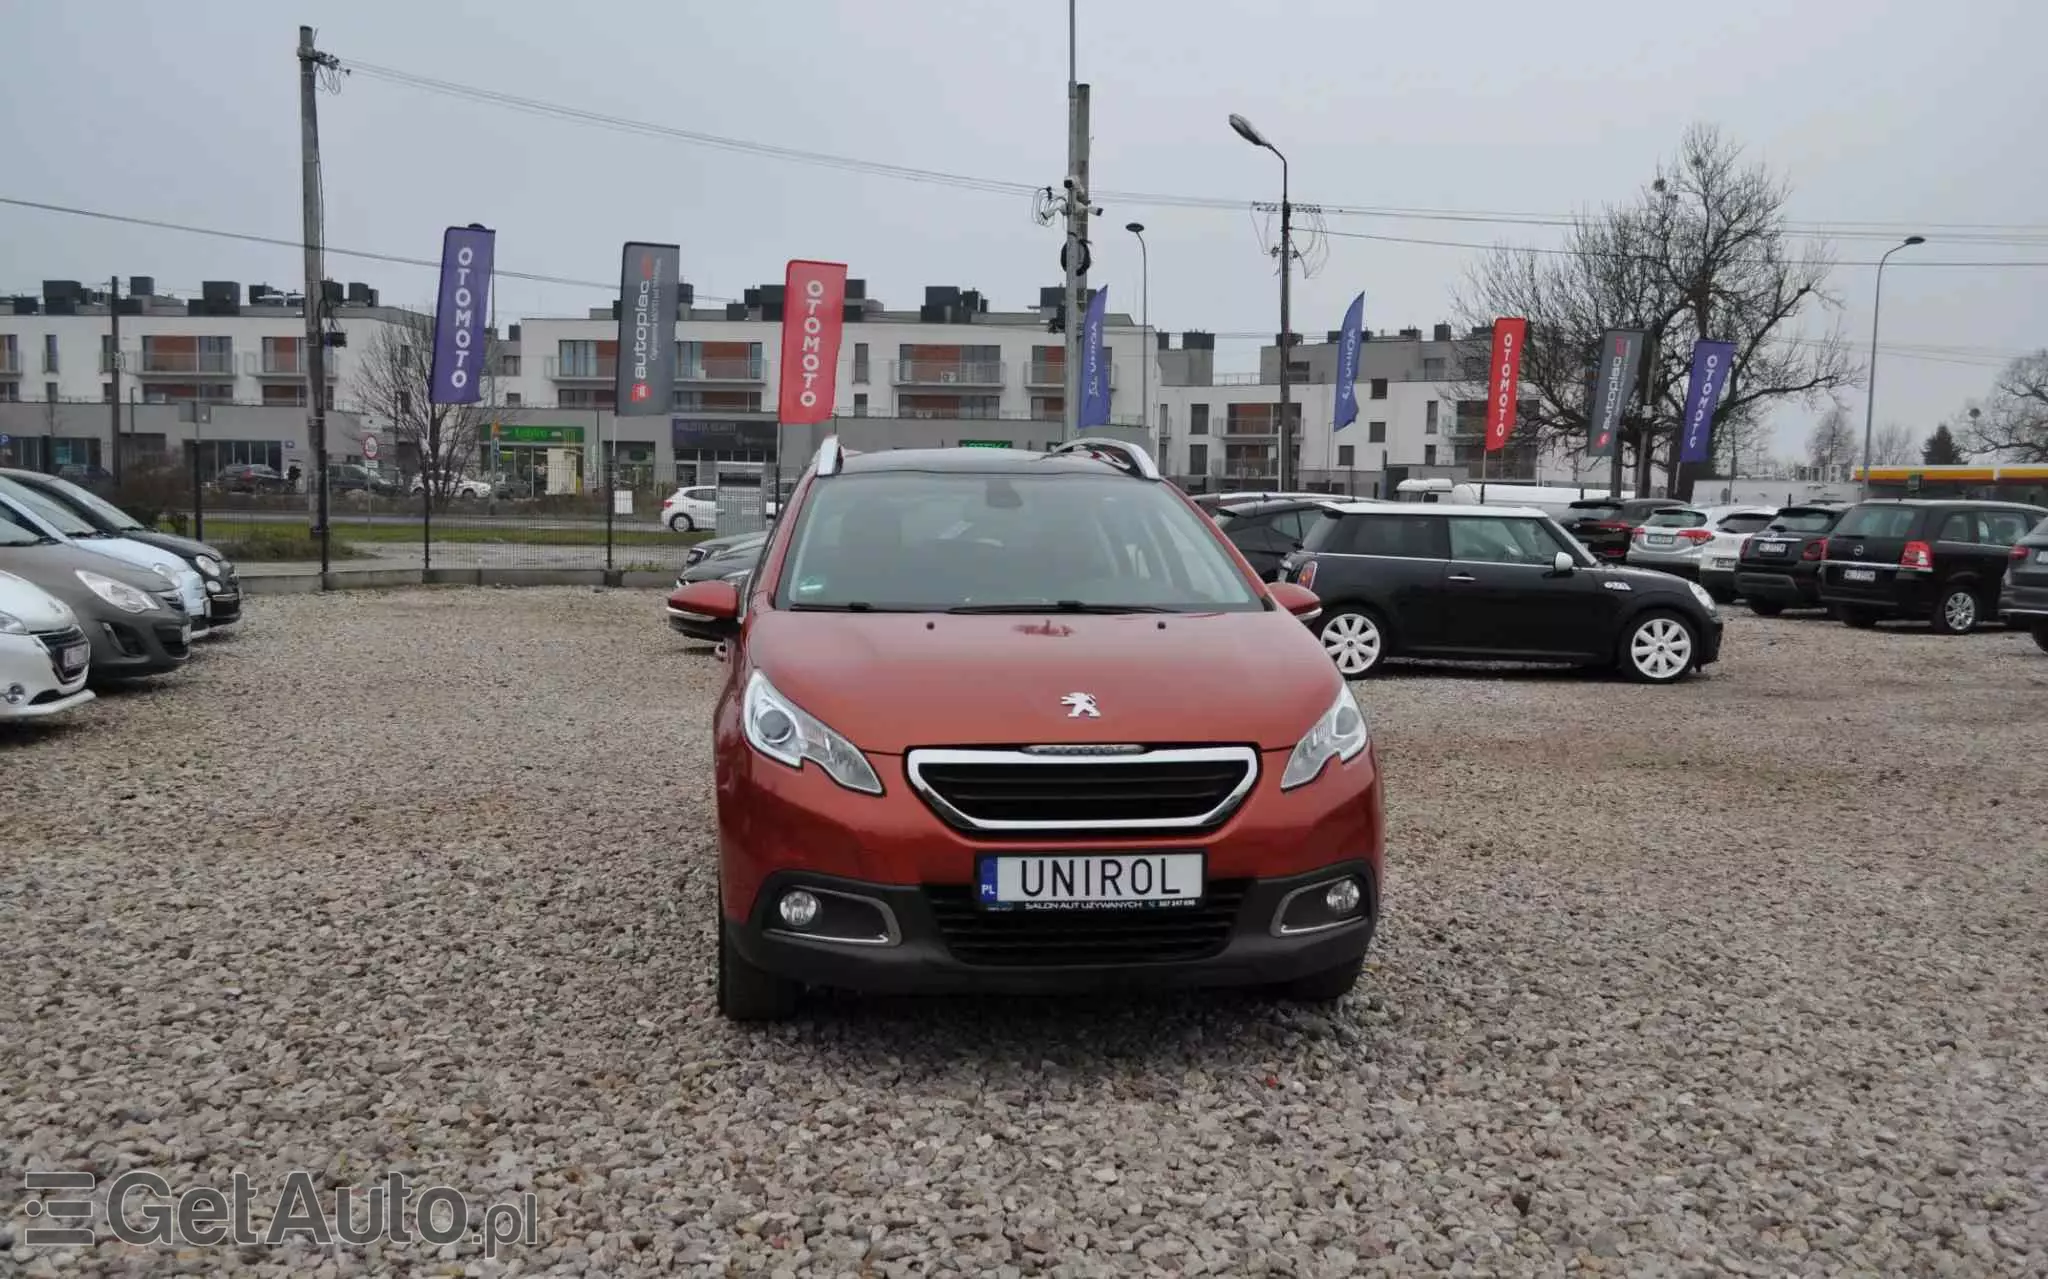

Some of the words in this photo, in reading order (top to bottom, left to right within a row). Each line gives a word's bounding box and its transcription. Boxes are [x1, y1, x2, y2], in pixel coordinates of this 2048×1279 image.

[451, 247, 473, 388] OTOMOTO
[800, 279, 823, 408] OTOMOTO
[1496, 333, 1513, 437] OTOMOTO
[981, 884, 996, 895] PL
[1021, 858, 1181, 897] UNIROL
[1024, 902, 1058, 910] SALON
